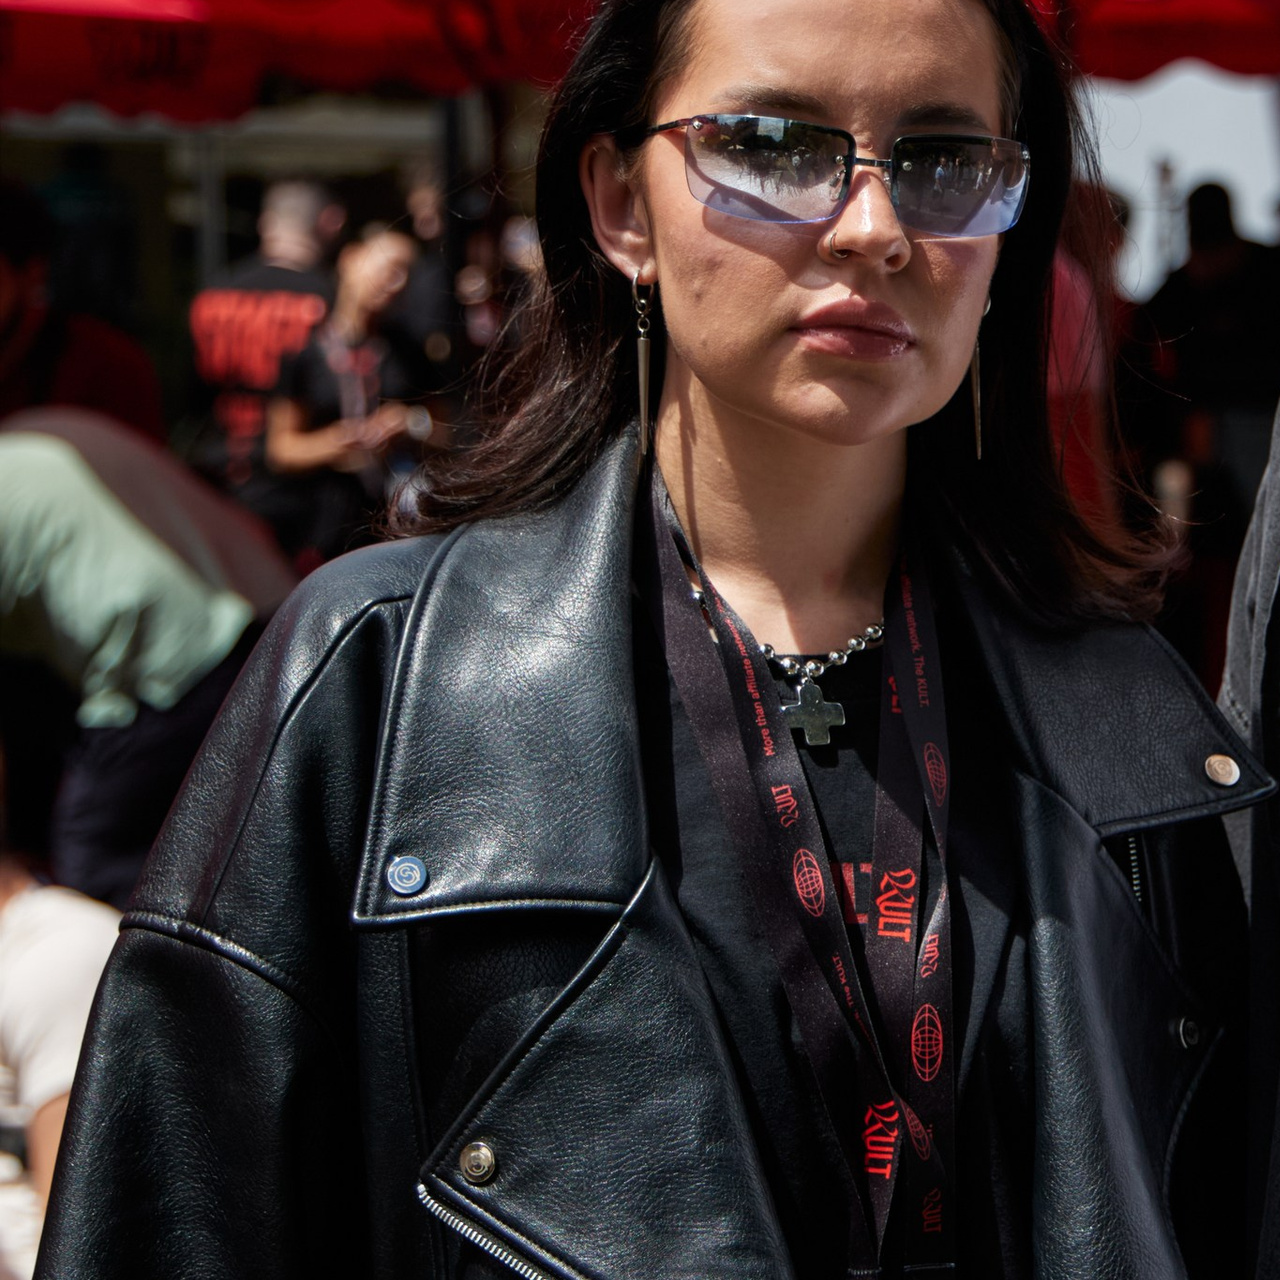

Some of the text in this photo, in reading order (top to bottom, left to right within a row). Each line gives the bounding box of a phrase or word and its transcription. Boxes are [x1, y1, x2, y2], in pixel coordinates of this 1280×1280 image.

[741, 657, 763, 701] affiliate
[753, 700, 770, 727] than
[758, 727, 776, 758] More
